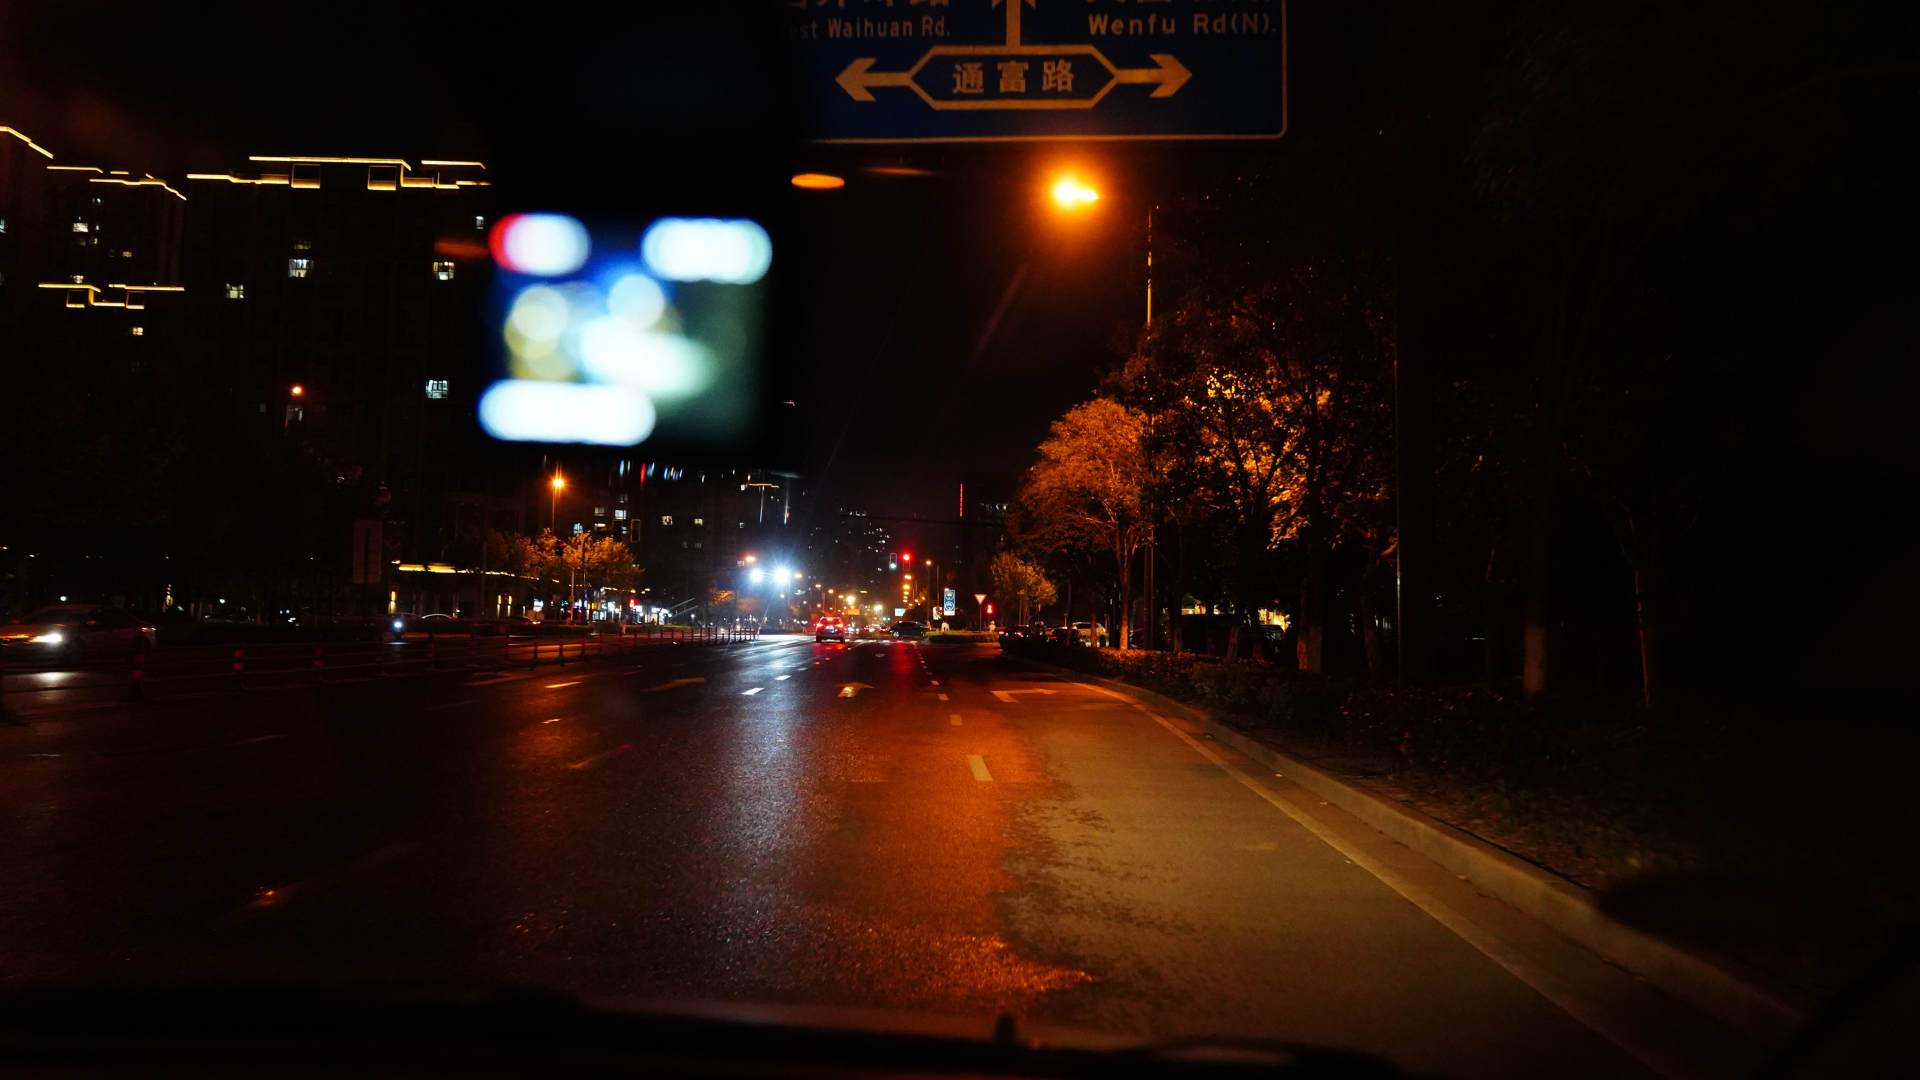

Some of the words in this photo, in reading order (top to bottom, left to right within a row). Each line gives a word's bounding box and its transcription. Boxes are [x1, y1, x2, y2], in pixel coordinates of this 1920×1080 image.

[828, 16, 913, 40] Waihuan
[921, 15, 951, 39] Rd.
[1088, 12, 1177, 37] Wenfu
[1193, 11, 1279, 36] Rd(N).
[952, 58, 1075, 95] 通富路
